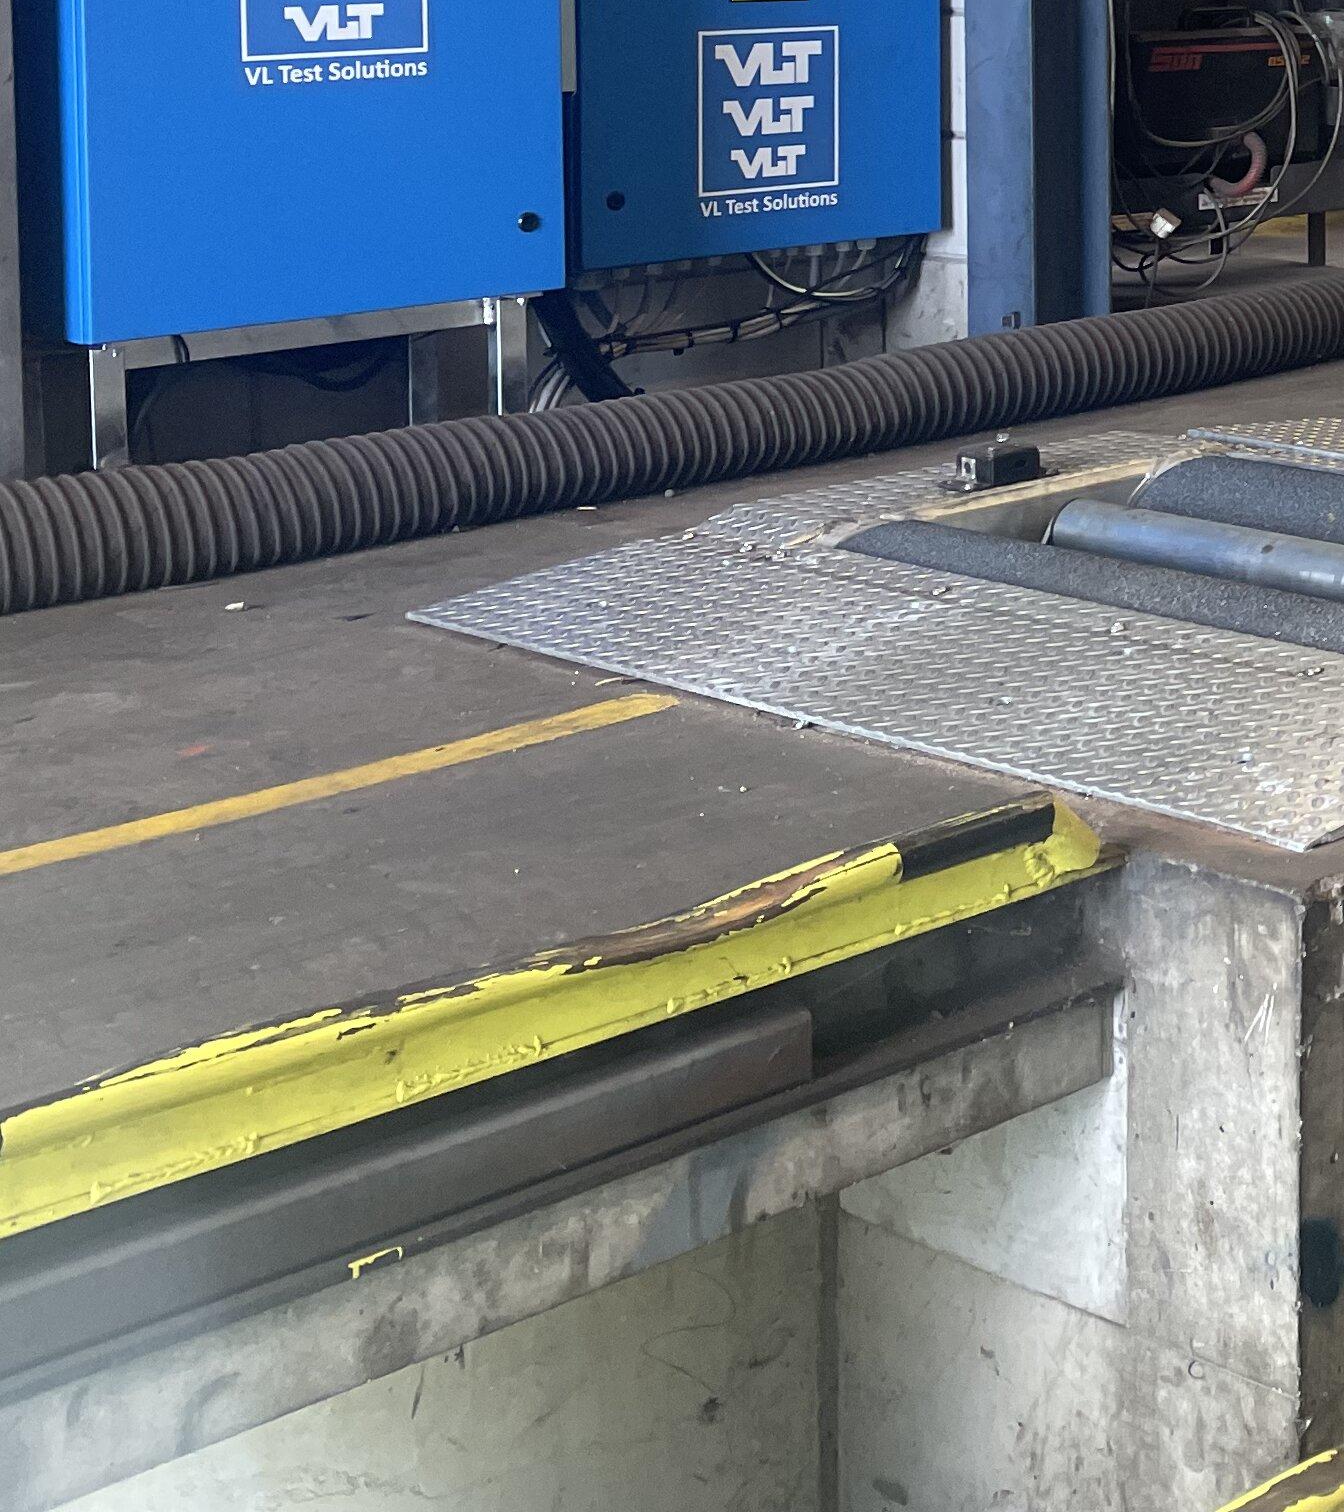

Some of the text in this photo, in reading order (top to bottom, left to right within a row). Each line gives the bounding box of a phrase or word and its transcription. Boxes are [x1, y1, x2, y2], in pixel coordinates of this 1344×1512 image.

[284, 3, 384, 42] VLT
[244, 59, 428, 86] VL Test Solutions
[715, 40, 822, 87] VLT
[722, 95, 815, 137] VLT
[730, 144, 806, 179] VLT
[700, 191, 838, 218] VL Test Solutions
